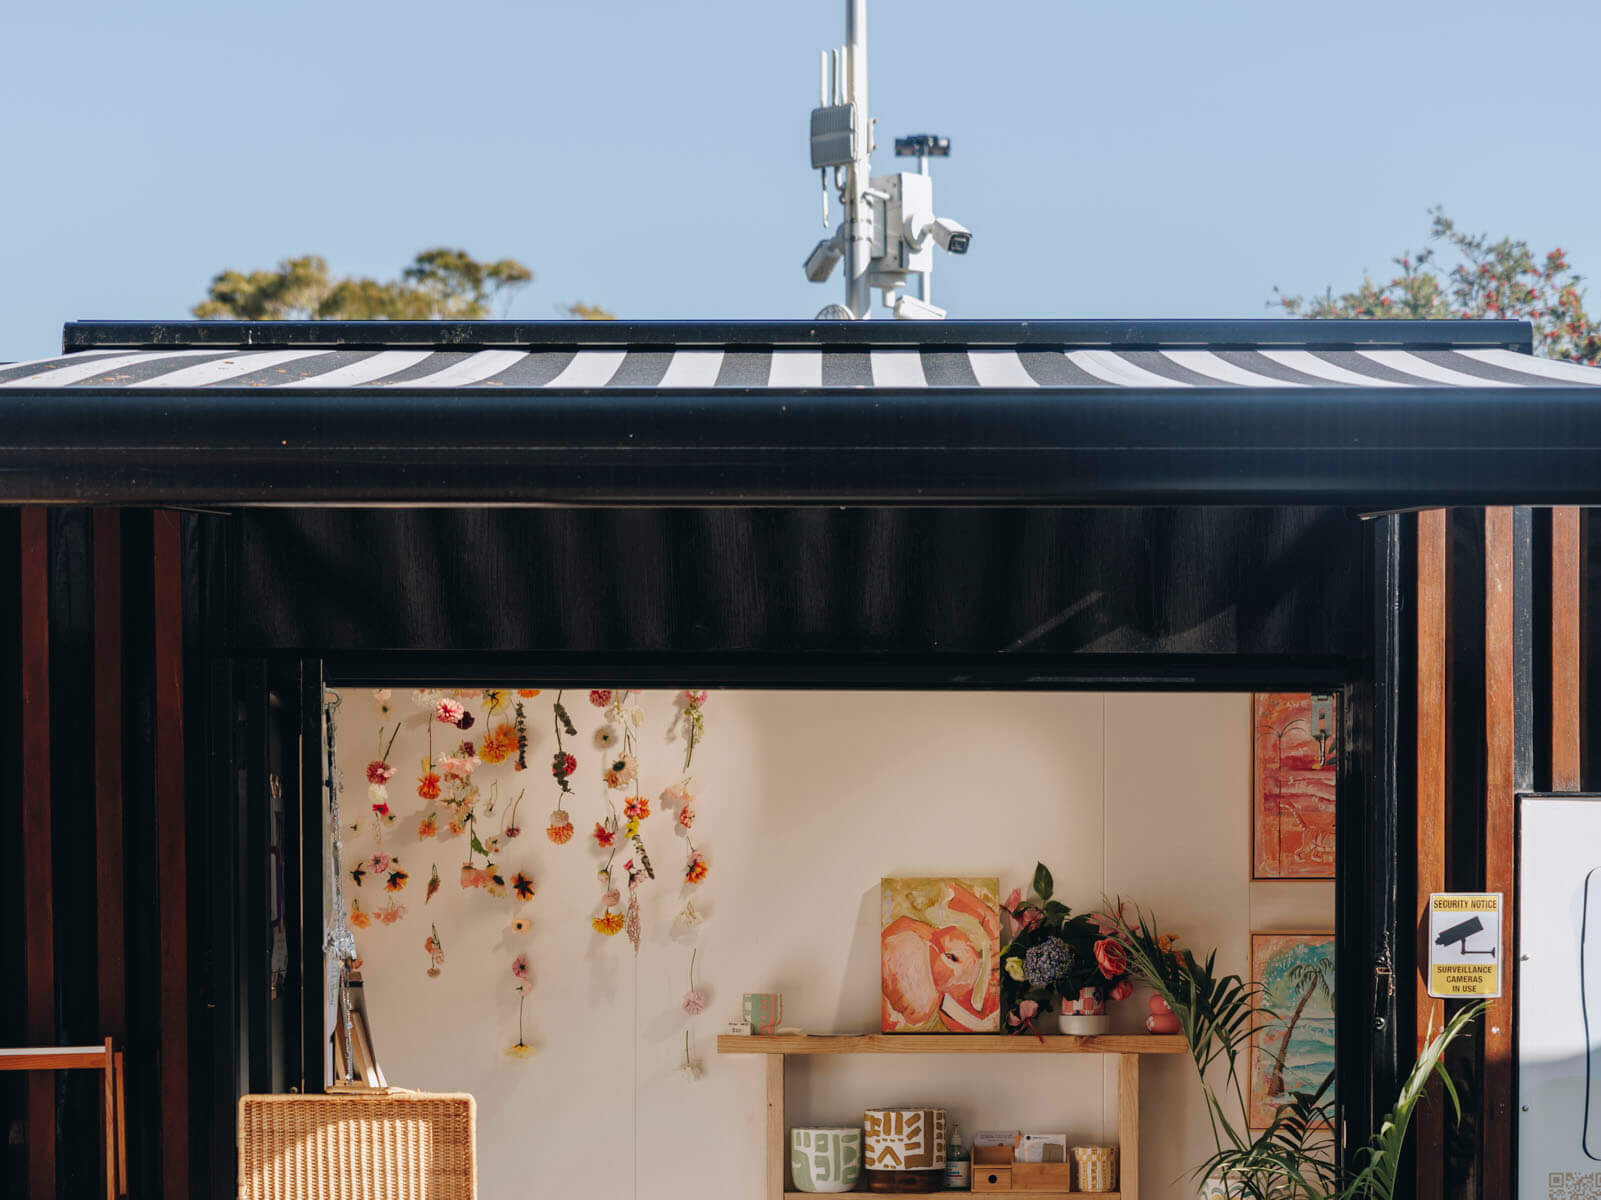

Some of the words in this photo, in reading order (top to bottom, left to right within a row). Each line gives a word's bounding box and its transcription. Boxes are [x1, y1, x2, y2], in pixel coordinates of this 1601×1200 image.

[1433, 899, 1468, 909] SECURITY
[1471, 899, 1497, 909] NOTICE
[1437, 966, 1492, 974] SURVEILLANCE
[1446, 975, 1483, 983] CAMERAS
